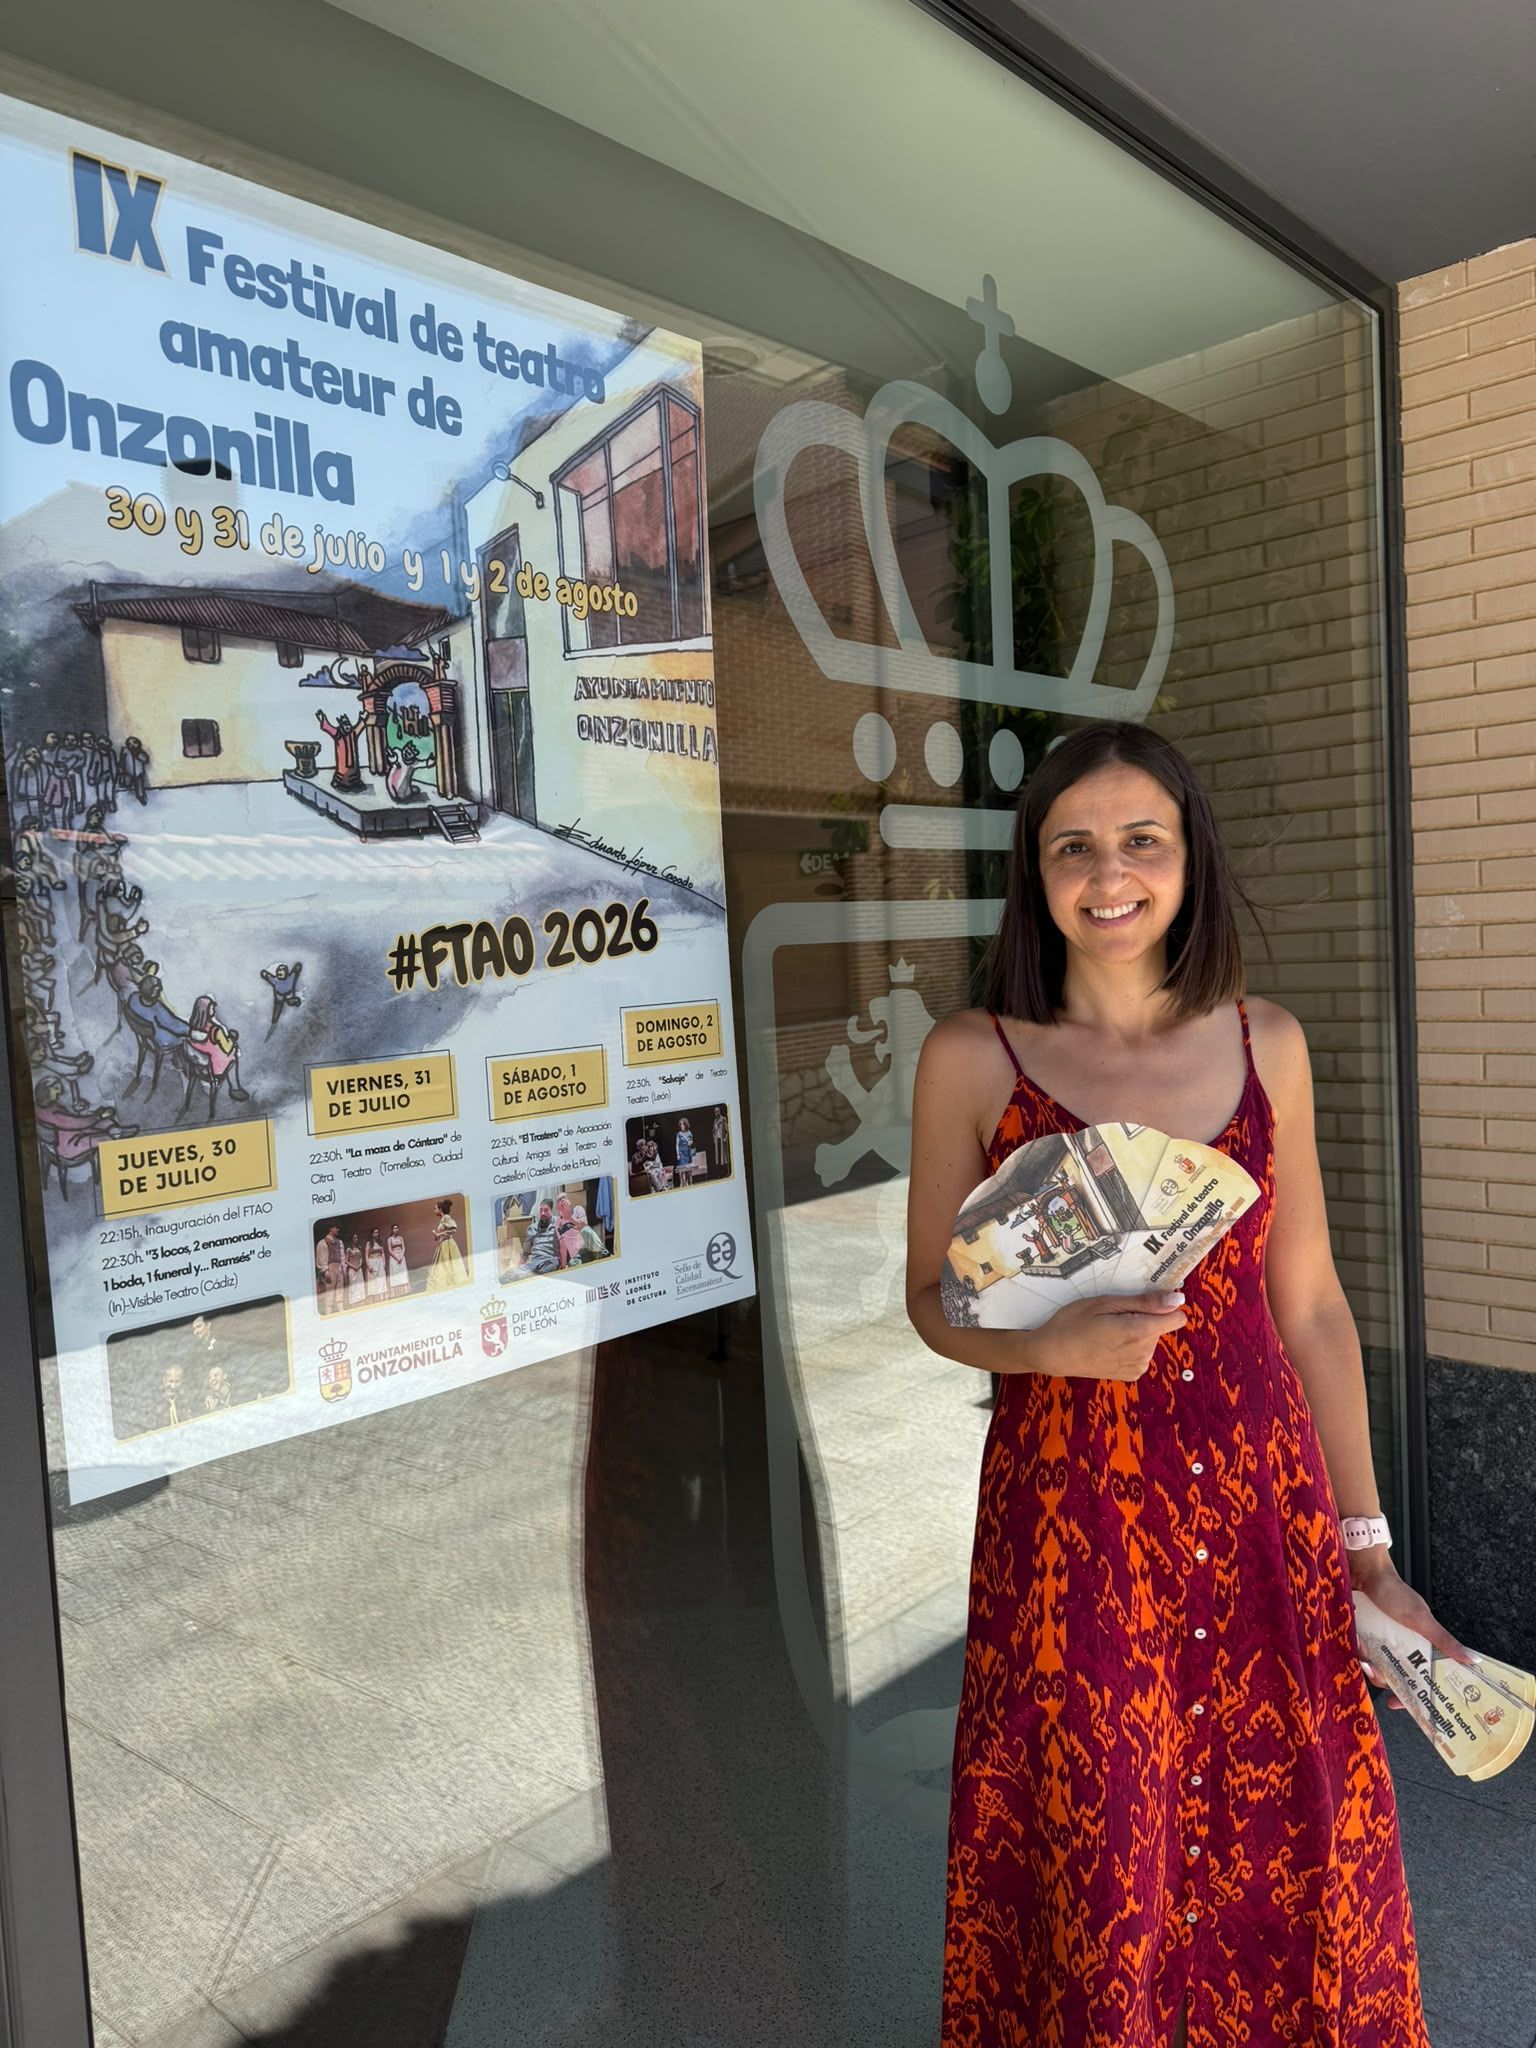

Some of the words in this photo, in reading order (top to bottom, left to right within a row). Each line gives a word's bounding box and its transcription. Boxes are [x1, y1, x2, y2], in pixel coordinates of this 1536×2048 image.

[69, 147, 170, 277] IX
[186, 226, 399, 343] Festival
[410, 303, 463, 362] de
[473, 320, 605, 404] teatro
[160, 320, 395, 416] amateur
[408, 376, 462, 436] de
[10, 359, 355, 505] Onzonilla
[105, 485, 166, 536] 30
[175, 506, 203, 556] y
[212, 505, 251, 550] 31
[261, 513, 306, 558] de
[306, 524, 387, 574] julio
[403, 549, 424, 593] y
[441, 549, 452, 585] 1
[460, 560, 481, 601] y
[488, 559, 508, 595] 2
[516, 561, 550, 602] de
[556, 576, 639, 621] agosto
[574, 676, 715, 708] AYUNTAMIENTO
[577, 714, 719, 767] ONZONILLA
[386, 914, 535, 992] #FTAO
[543, 897, 659, 970] 2026
[636, 1016, 704, 1034] DOMINGO,
[706, 1015, 713, 1027] 2
[637, 1038, 654, 1052] DE
[657, 1033, 707, 1050] AGOSTO
[326, 1073, 409, 1096] VIERNES,
[414, 1070, 431, 1085] 31
[502, 1066, 566, 1086] SÁBADO,
[570, 1064, 576, 1077] 1
[695, 1070, 704, 1080] de
[710, 1068, 728, 1078] Teatro
[329, 1100, 352, 1118] DE
[359, 1093, 411, 1114] JULIO
[504, 1090, 523, 1106] DE
[527, 1082, 587, 1102] AGOSTO
[627, 1095, 649, 1105] Teatro
[651, 1089, 671, 1104] (León)
[345, 1147, 363, 1158] "La
[364, 1144, 391, 1156] moza
[392, 1140, 405, 1151] de
[408, 1133, 448, 1149] Cántaro"
[450, 1130, 462, 1142] de
[530, 1128, 562, 1142] Trastero"
[563, 1126, 574, 1137] de
[576, 1121, 612, 1135] Asociación
[117, 1144, 205, 1172] JUEVES,
[212, 1138, 236, 1157] 30
[310, 1172, 335, 1185] Citra
[342, 1167, 372, 1180] Teatro
[379, 1158, 426, 1176] (Tomelloso,
[432, 1148, 463, 1164] Ciudad
[492, 1152, 519, 1168] Cultural
[525, 1149, 551, 1162] Amigos
[557, 1143, 569, 1155] del
[575, 1141, 597, 1152] Teatro
[602, 1136, 613, 1147] de
[119, 1176, 147, 1196] DE
[156, 1165, 217, 1190] JULIO
[493, 1169, 526, 1185] Castellón
[526, 1162, 560, 1181] (Castellón
[561, 1160, 571, 1171] de
[571, 1158, 579, 1169] la
[580, 1154, 601, 1169] Plana)
[312, 1189, 336, 1205] Real)
[100, 1226, 143, 1245] 22:15h.
[145, 1212, 220, 1236] Inauguración
[223, 1205, 241, 1221] del
[243, 1201, 273, 1218] FTAO
[1143, 1234, 1164, 1255] IX
[1161, 1210, 1190, 1241] Festival
[1186, 1199, 1198, 1213] de
[1194, 1177, 1219, 1203] teatro
[102, 1252, 144, 1270] 22:30h.
[146, 1248, 159, 1261] "3
[160, 1243, 192, 1259] locos,
[192, 1240, 200, 1252] 2
[201, 1227, 270, 1250] enamorados,
[1150, 1250, 1178, 1283] amateur
[1176, 1240, 1188, 1253] de
[1183, 1198, 1225, 1242] Onzonilla
[103, 1280, 109, 1292] 1
[111, 1274, 146, 1291] boda,
[147, 1271, 152, 1283] 1
[153, 1264, 192, 1282] funeral
[211, 1250, 256, 1269] Ramsés"
[257, 1246, 272, 1260] de
[625, 1271, 660, 1285] INSTITUTO
[674, 1261, 692, 1275] Sello
[692, 1260, 702, 1269] de
[675, 1270, 702, 1285] Calidad
[108, 1290, 163, 1318] (In)-Visible
[164, 1285, 199, 1302] Teatro
[200, 1272, 238, 1296] (Cádiz)
[626, 1283, 651, 1295] LEONÉS
[638, 1289, 667, 1302] CULTURA
[676, 1276, 723, 1296] Escenamateur
[512, 1297, 576, 1324] DIPUTACIÓN
[513, 1324, 527, 1337] DE
[529, 1314, 557, 1333] LEÓN
[356, 1333, 444, 1367] AYUNTAMIENTO
[449, 1329, 463, 1343] DE
[358, 1342, 464, 1384] ONZONILLA
[1380, 1644, 1409, 1682] amateur
[1407, 1677, 1418, 1691] de
[1416, 1689, 1457, 1740] Onzonilla
[1407, 1649, 1428, 1670] IX
[1419, 1668, 1448, 1703] Festival
[1445, 1701, 1456, 1714] de
[1454, 1712, 1477, 1742] teatro
